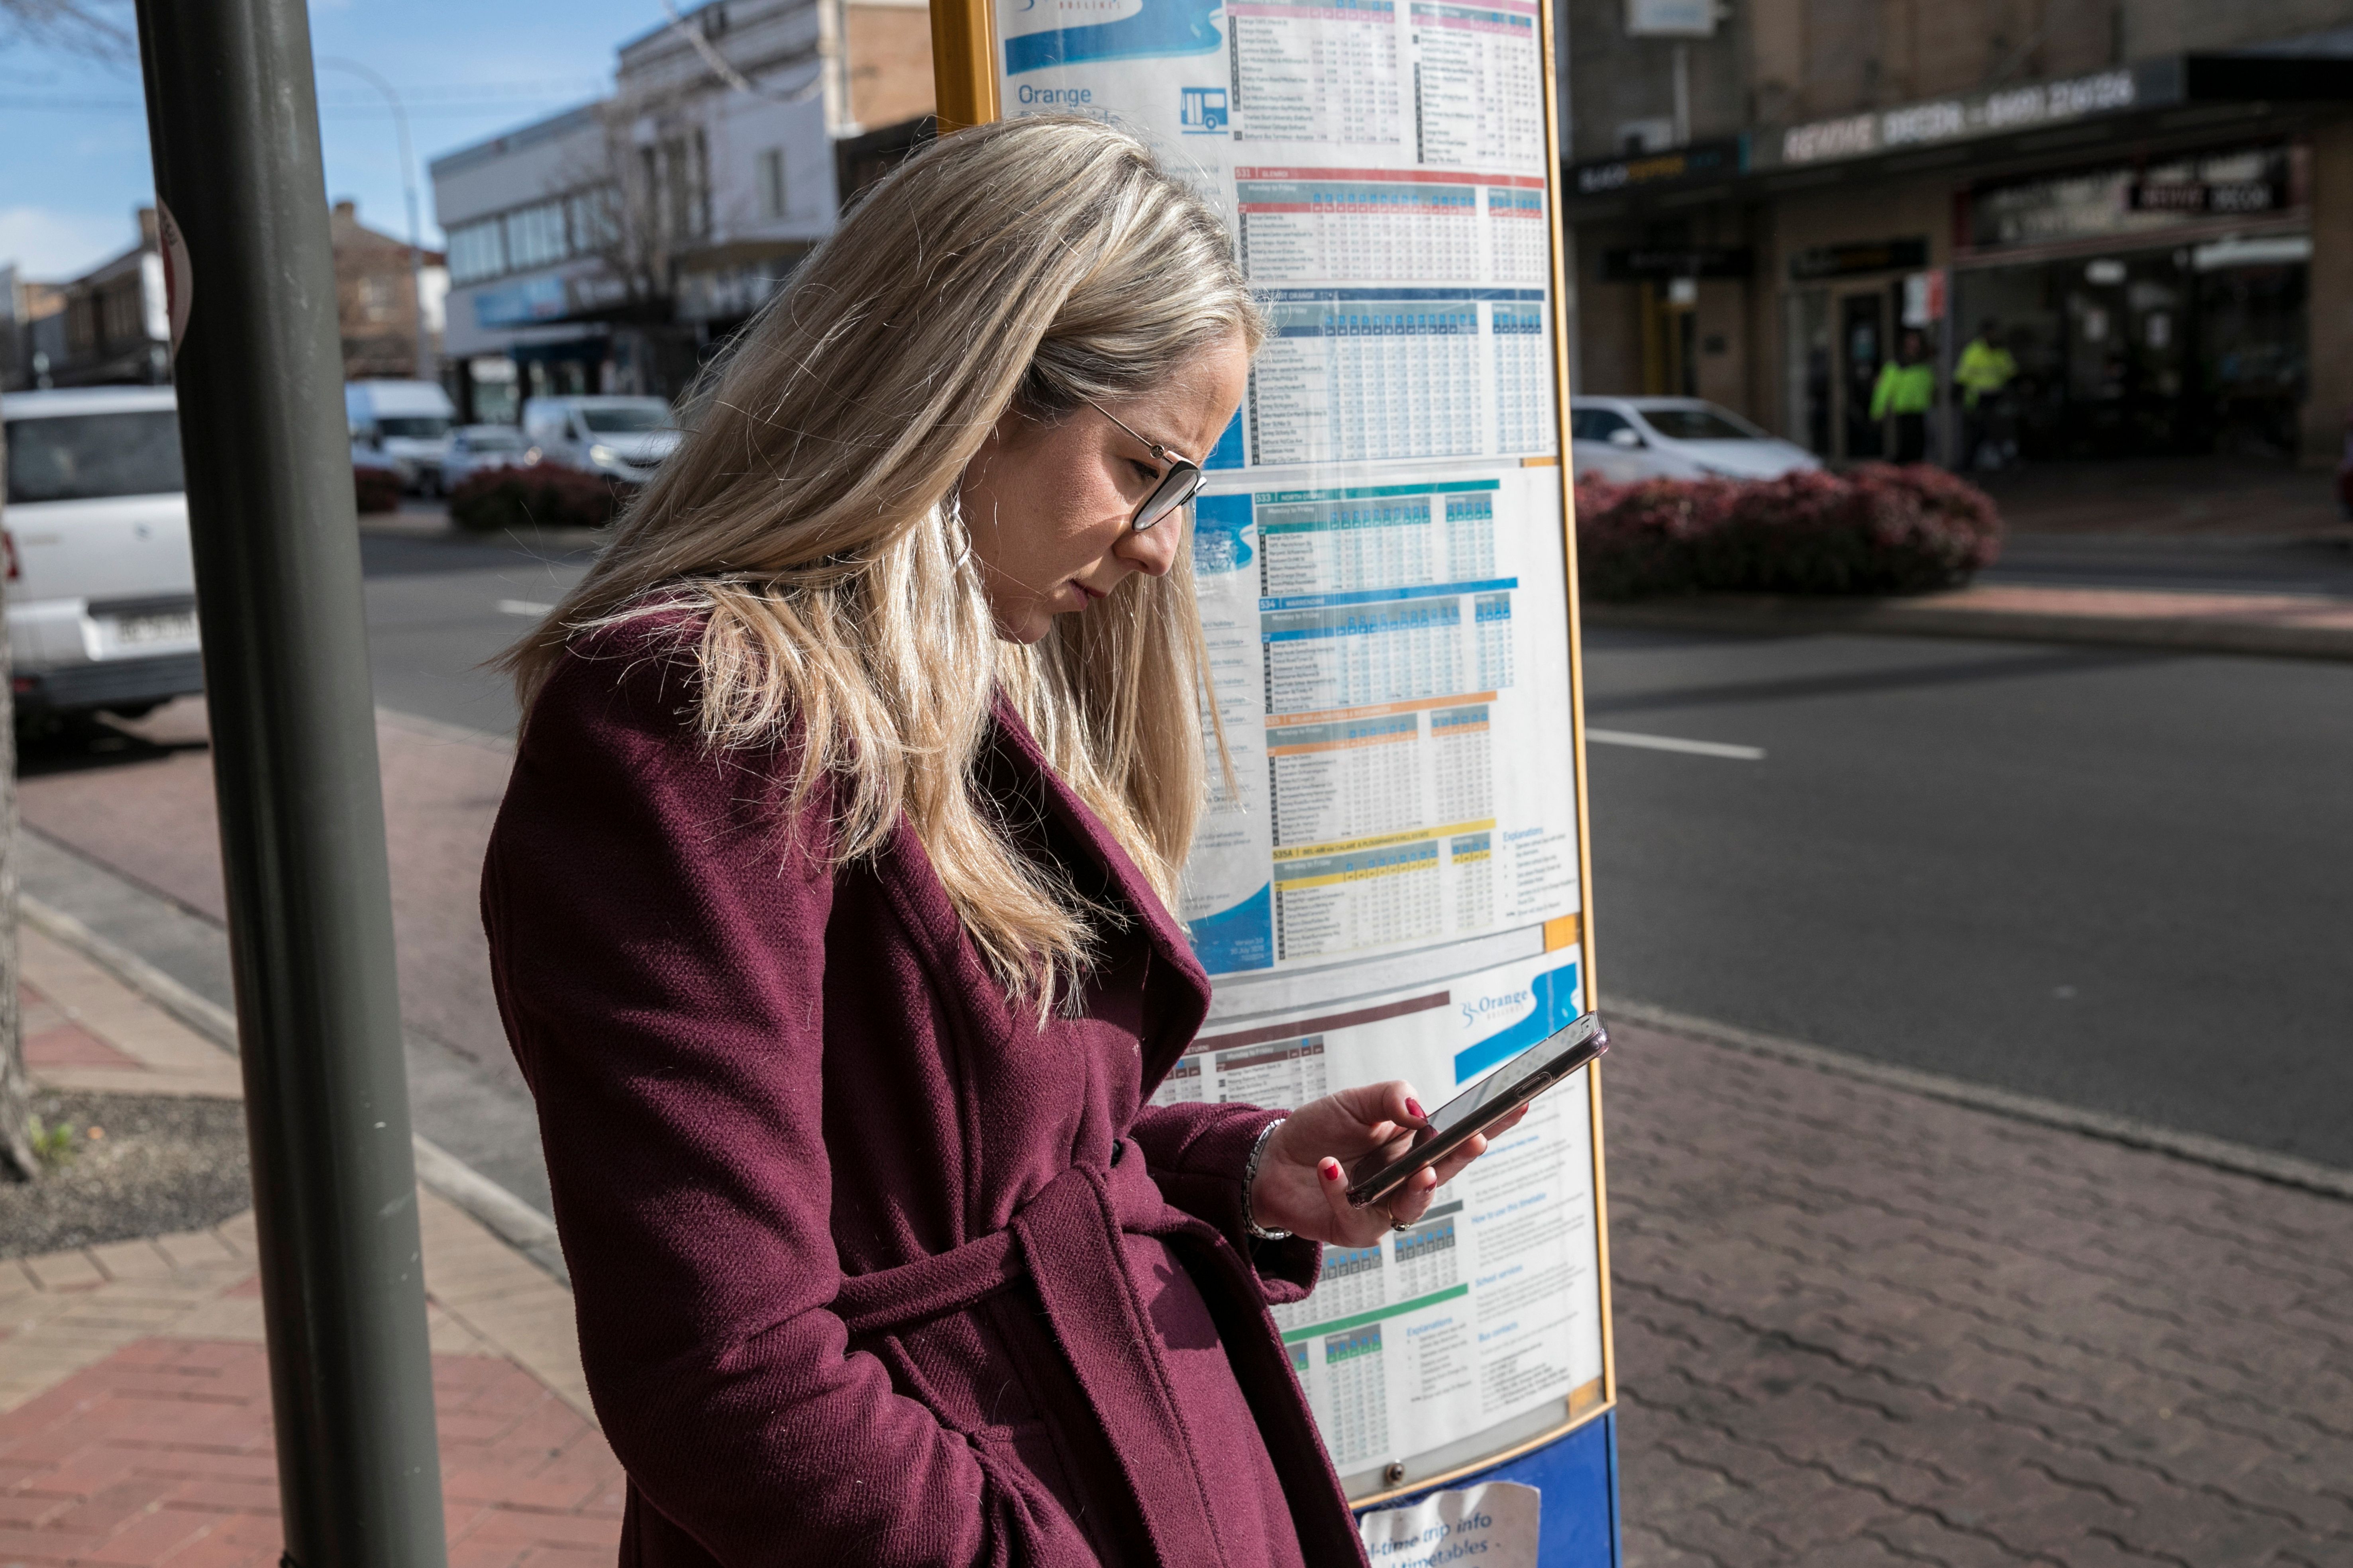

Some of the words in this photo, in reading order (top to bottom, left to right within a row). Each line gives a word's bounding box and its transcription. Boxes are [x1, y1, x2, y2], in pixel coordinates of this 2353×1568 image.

[1059, 0, 1121, 10] BUSLINES
[1018, 84, 1092, 107] Orange
[1236, 169, 1251, 178] 531
[1256, 494, 1271, 503] 533
[1260, 600, 1275, 609] 534
[1503, 826, 1543, 842] Explanations
[1273, 849, 1293, 859] 535A
[1479, 989, 1527, 1014] Orange
[1227, 1051, 1248, 1060] Monday
[1471, 1214, 1486, 1224] How
[1475, 1274, 1497, 1288] School
[1407, 1317, 1453, 1337] Explanations
[1478, 1332, 1491, 1343] Bus
[1423, 1522, 1452, 1547] trip
[1456, 1512, 1493, 1534] info
